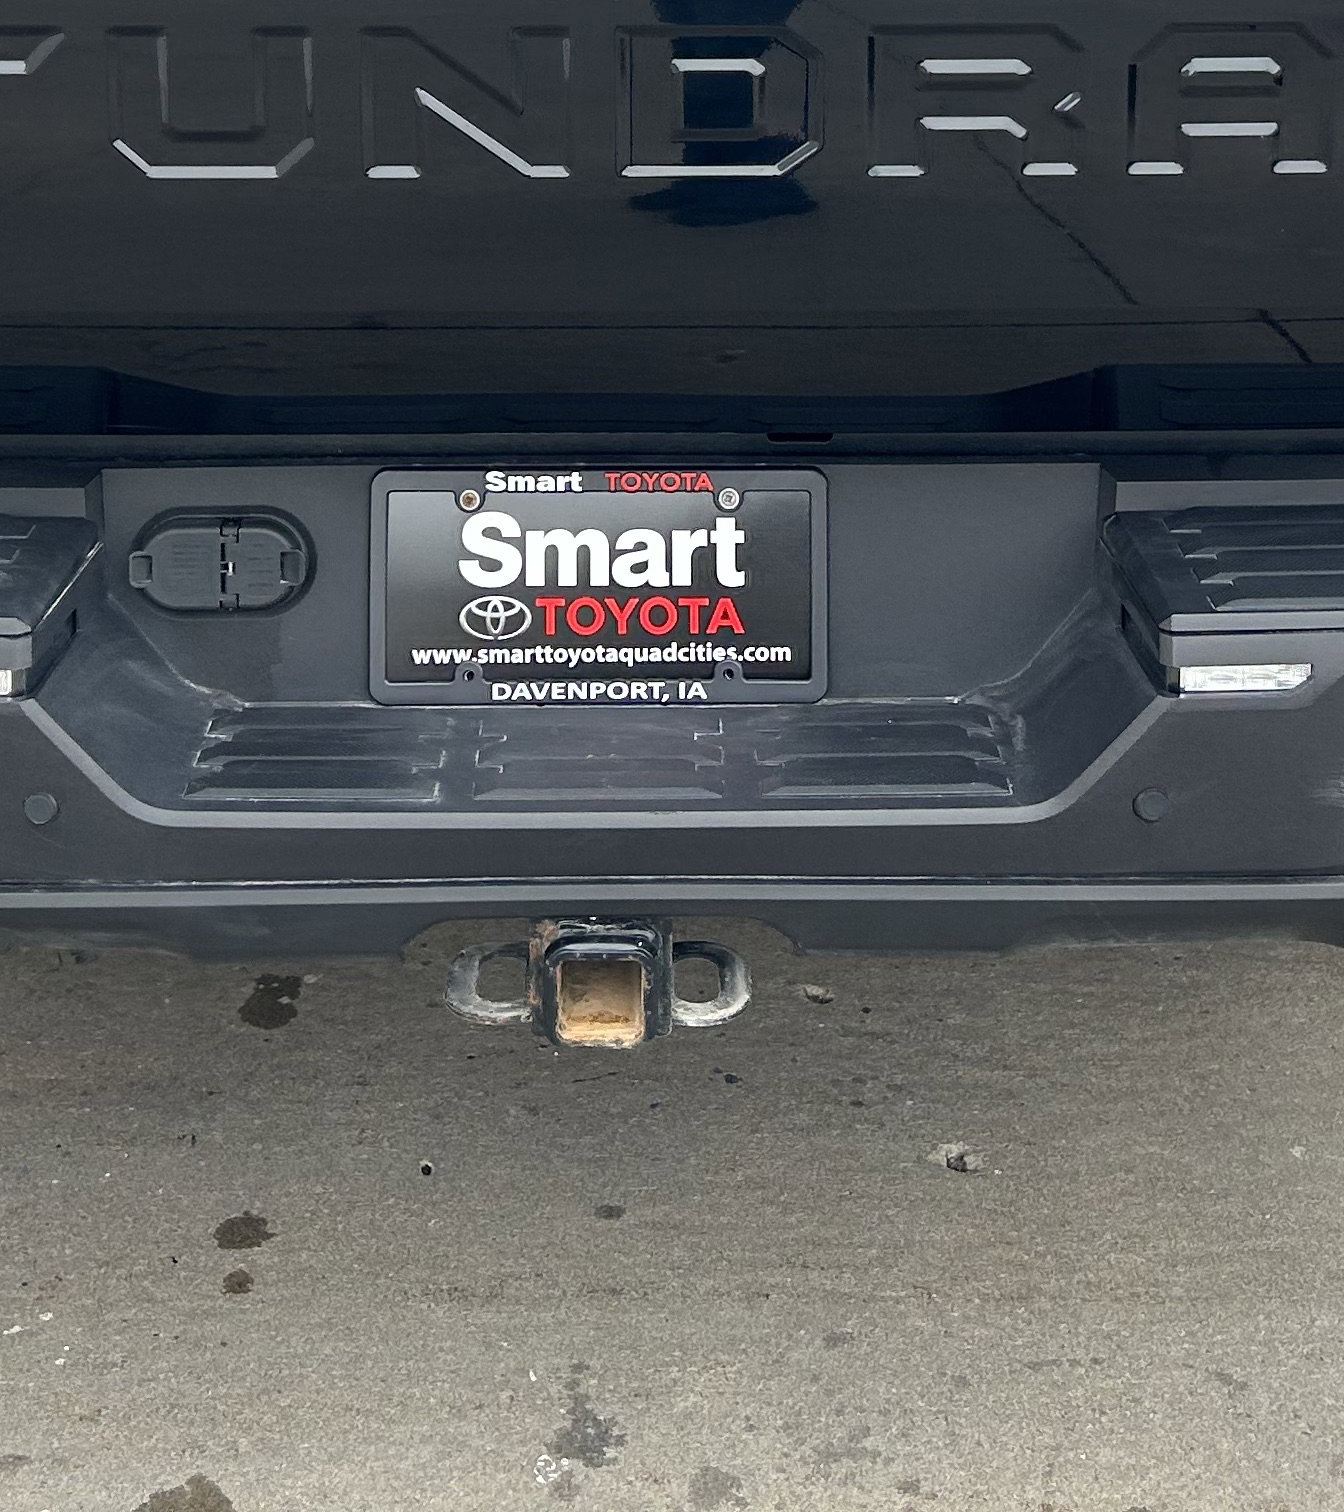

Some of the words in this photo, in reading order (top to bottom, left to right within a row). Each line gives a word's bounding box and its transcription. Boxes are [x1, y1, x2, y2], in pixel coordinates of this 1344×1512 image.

[485, 471, 583, 492] Smart
[606, 472, 714, 492] TOYOTA
[458, 511, 746, 589] Smart
[536, 597, 745, 635] TOYOTA
[412, 642, 792, 667] www.smarttoyotaquadcities.com
[492, 683, 670, 702] DAVENPORT,
[678, 683, 708, 701] IA
